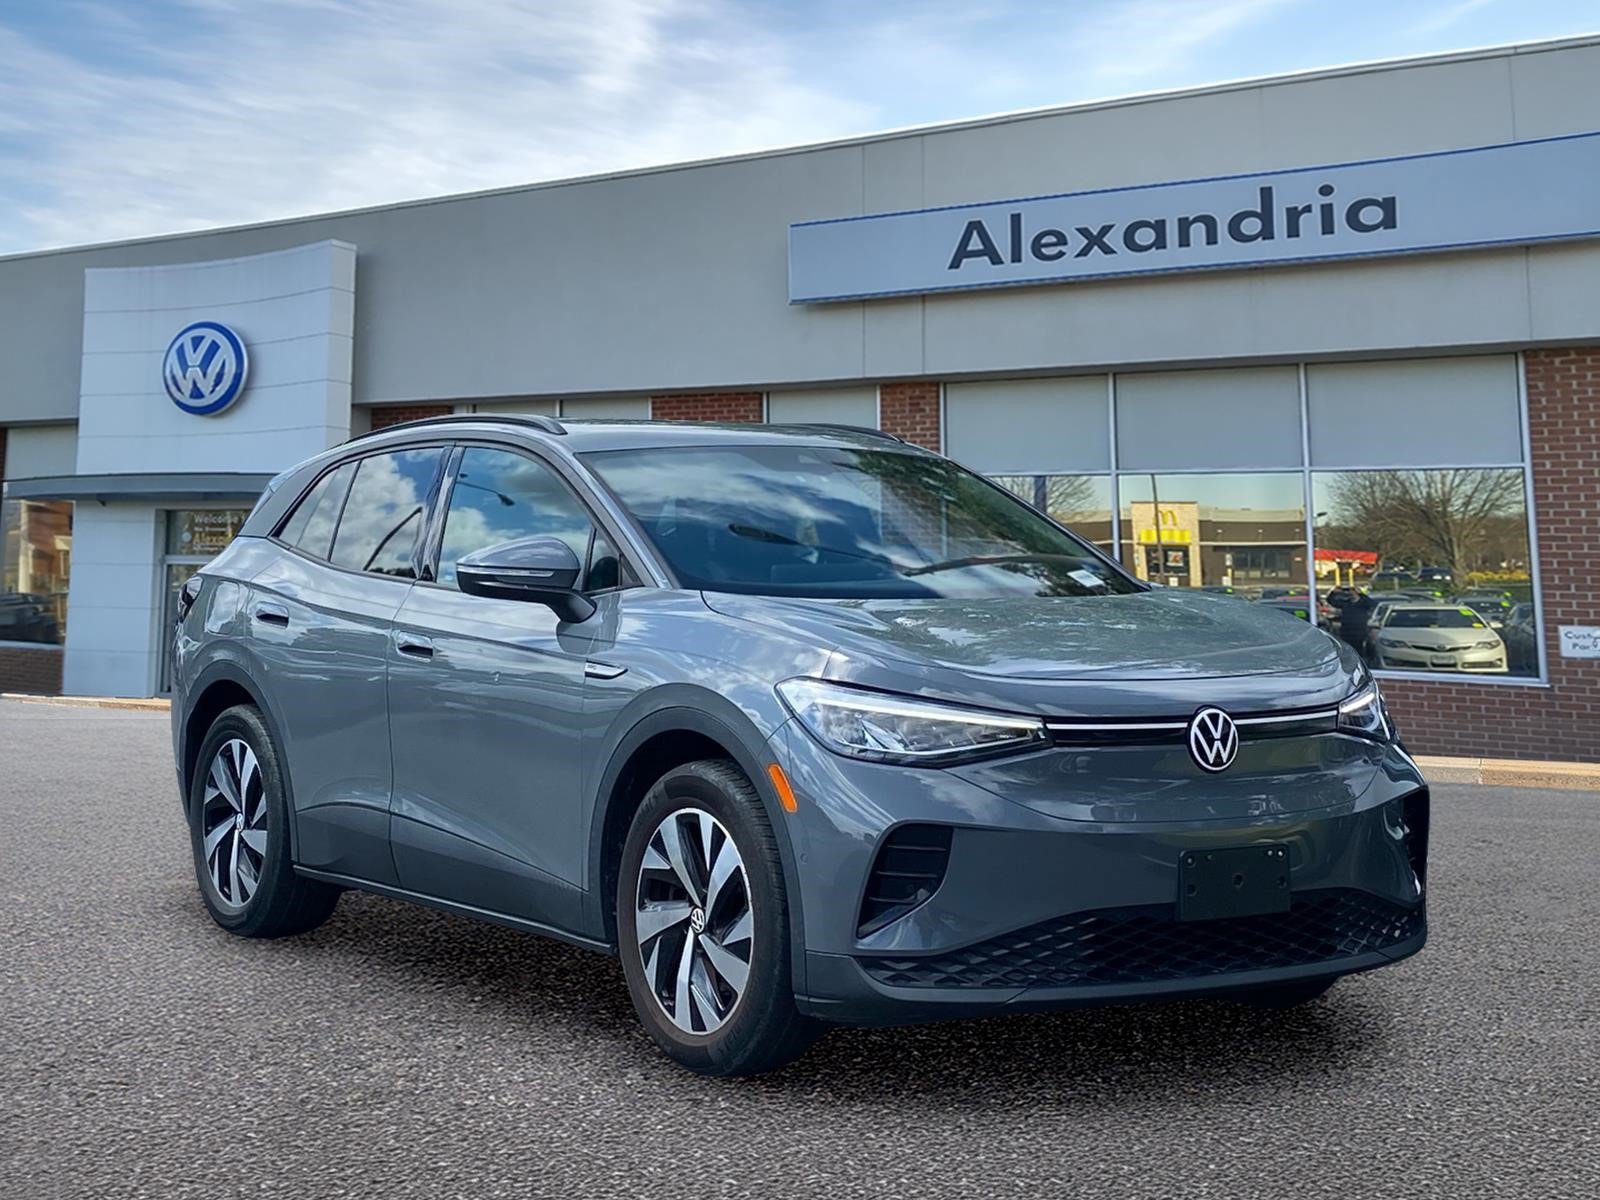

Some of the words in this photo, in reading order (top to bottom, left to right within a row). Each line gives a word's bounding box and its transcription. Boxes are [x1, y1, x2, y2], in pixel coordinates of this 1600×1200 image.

[948, 184, 1398, 270] Alexandria
[164, 325, 239, 409] VW
[1191, 708, 1239, 771] VW
